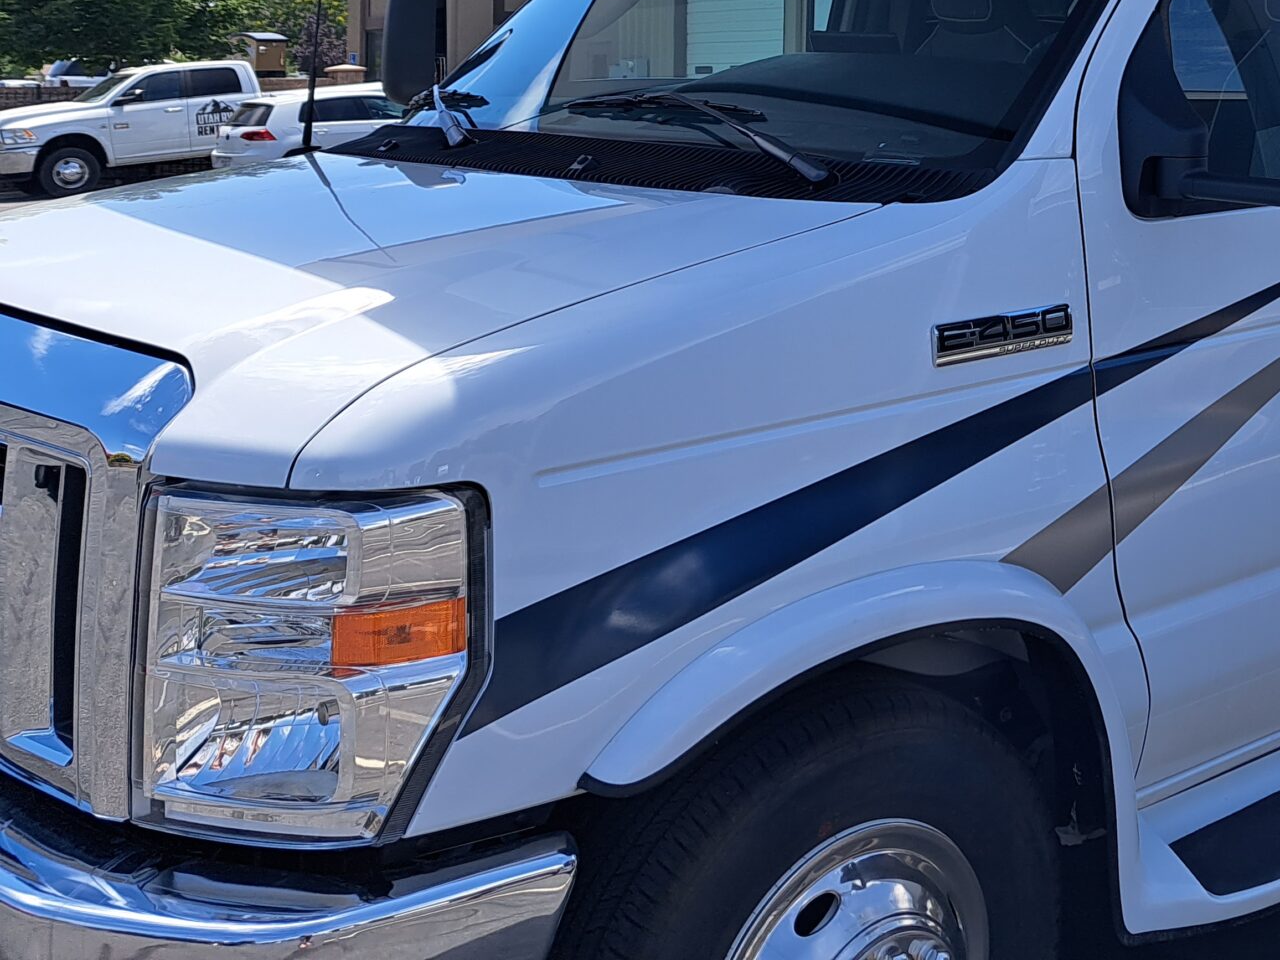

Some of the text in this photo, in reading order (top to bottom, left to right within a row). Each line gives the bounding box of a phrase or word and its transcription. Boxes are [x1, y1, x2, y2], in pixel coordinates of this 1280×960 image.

[197, 112, 220, 124] UTAH
[197, 124, 220, 137] RENT
[999, 335, 1070, 355] SUPER DUTY
